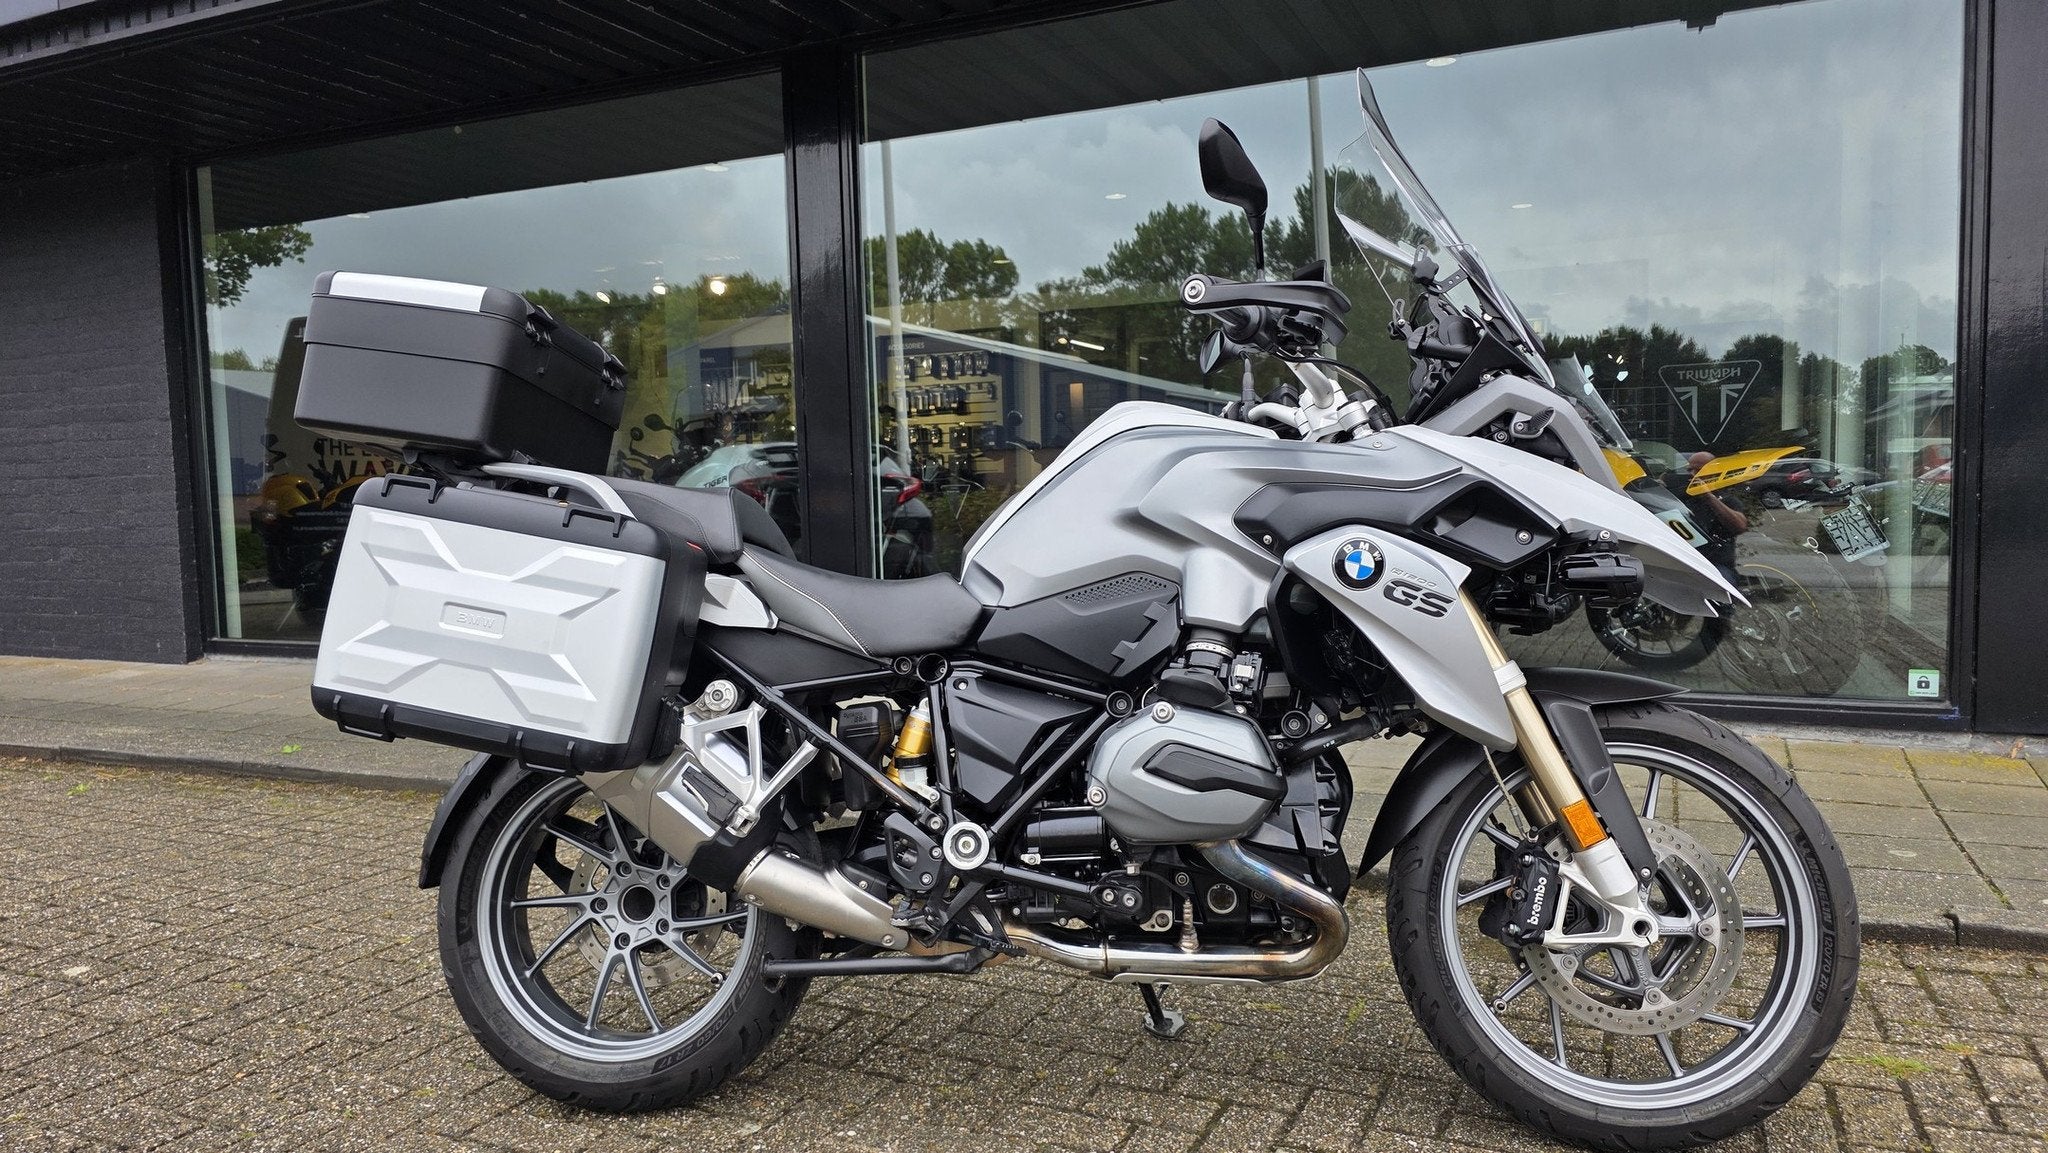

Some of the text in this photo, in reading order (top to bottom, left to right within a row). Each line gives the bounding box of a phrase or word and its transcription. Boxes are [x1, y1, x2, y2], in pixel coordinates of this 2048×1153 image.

[1677, 366, 1741, 381] TRIUMPH
[703, 476, 728, 488] TIGER
[1342, 541, 1383, 562] BMW
[1383, 579, 1456, 618] GS
[456, 611, 496, 629] BMW
[1527, 876, 1548, 926] brembo
[1805, 855, 1832, 923] MICHELIN
[1822, 936, 1833, 971] 120/70
